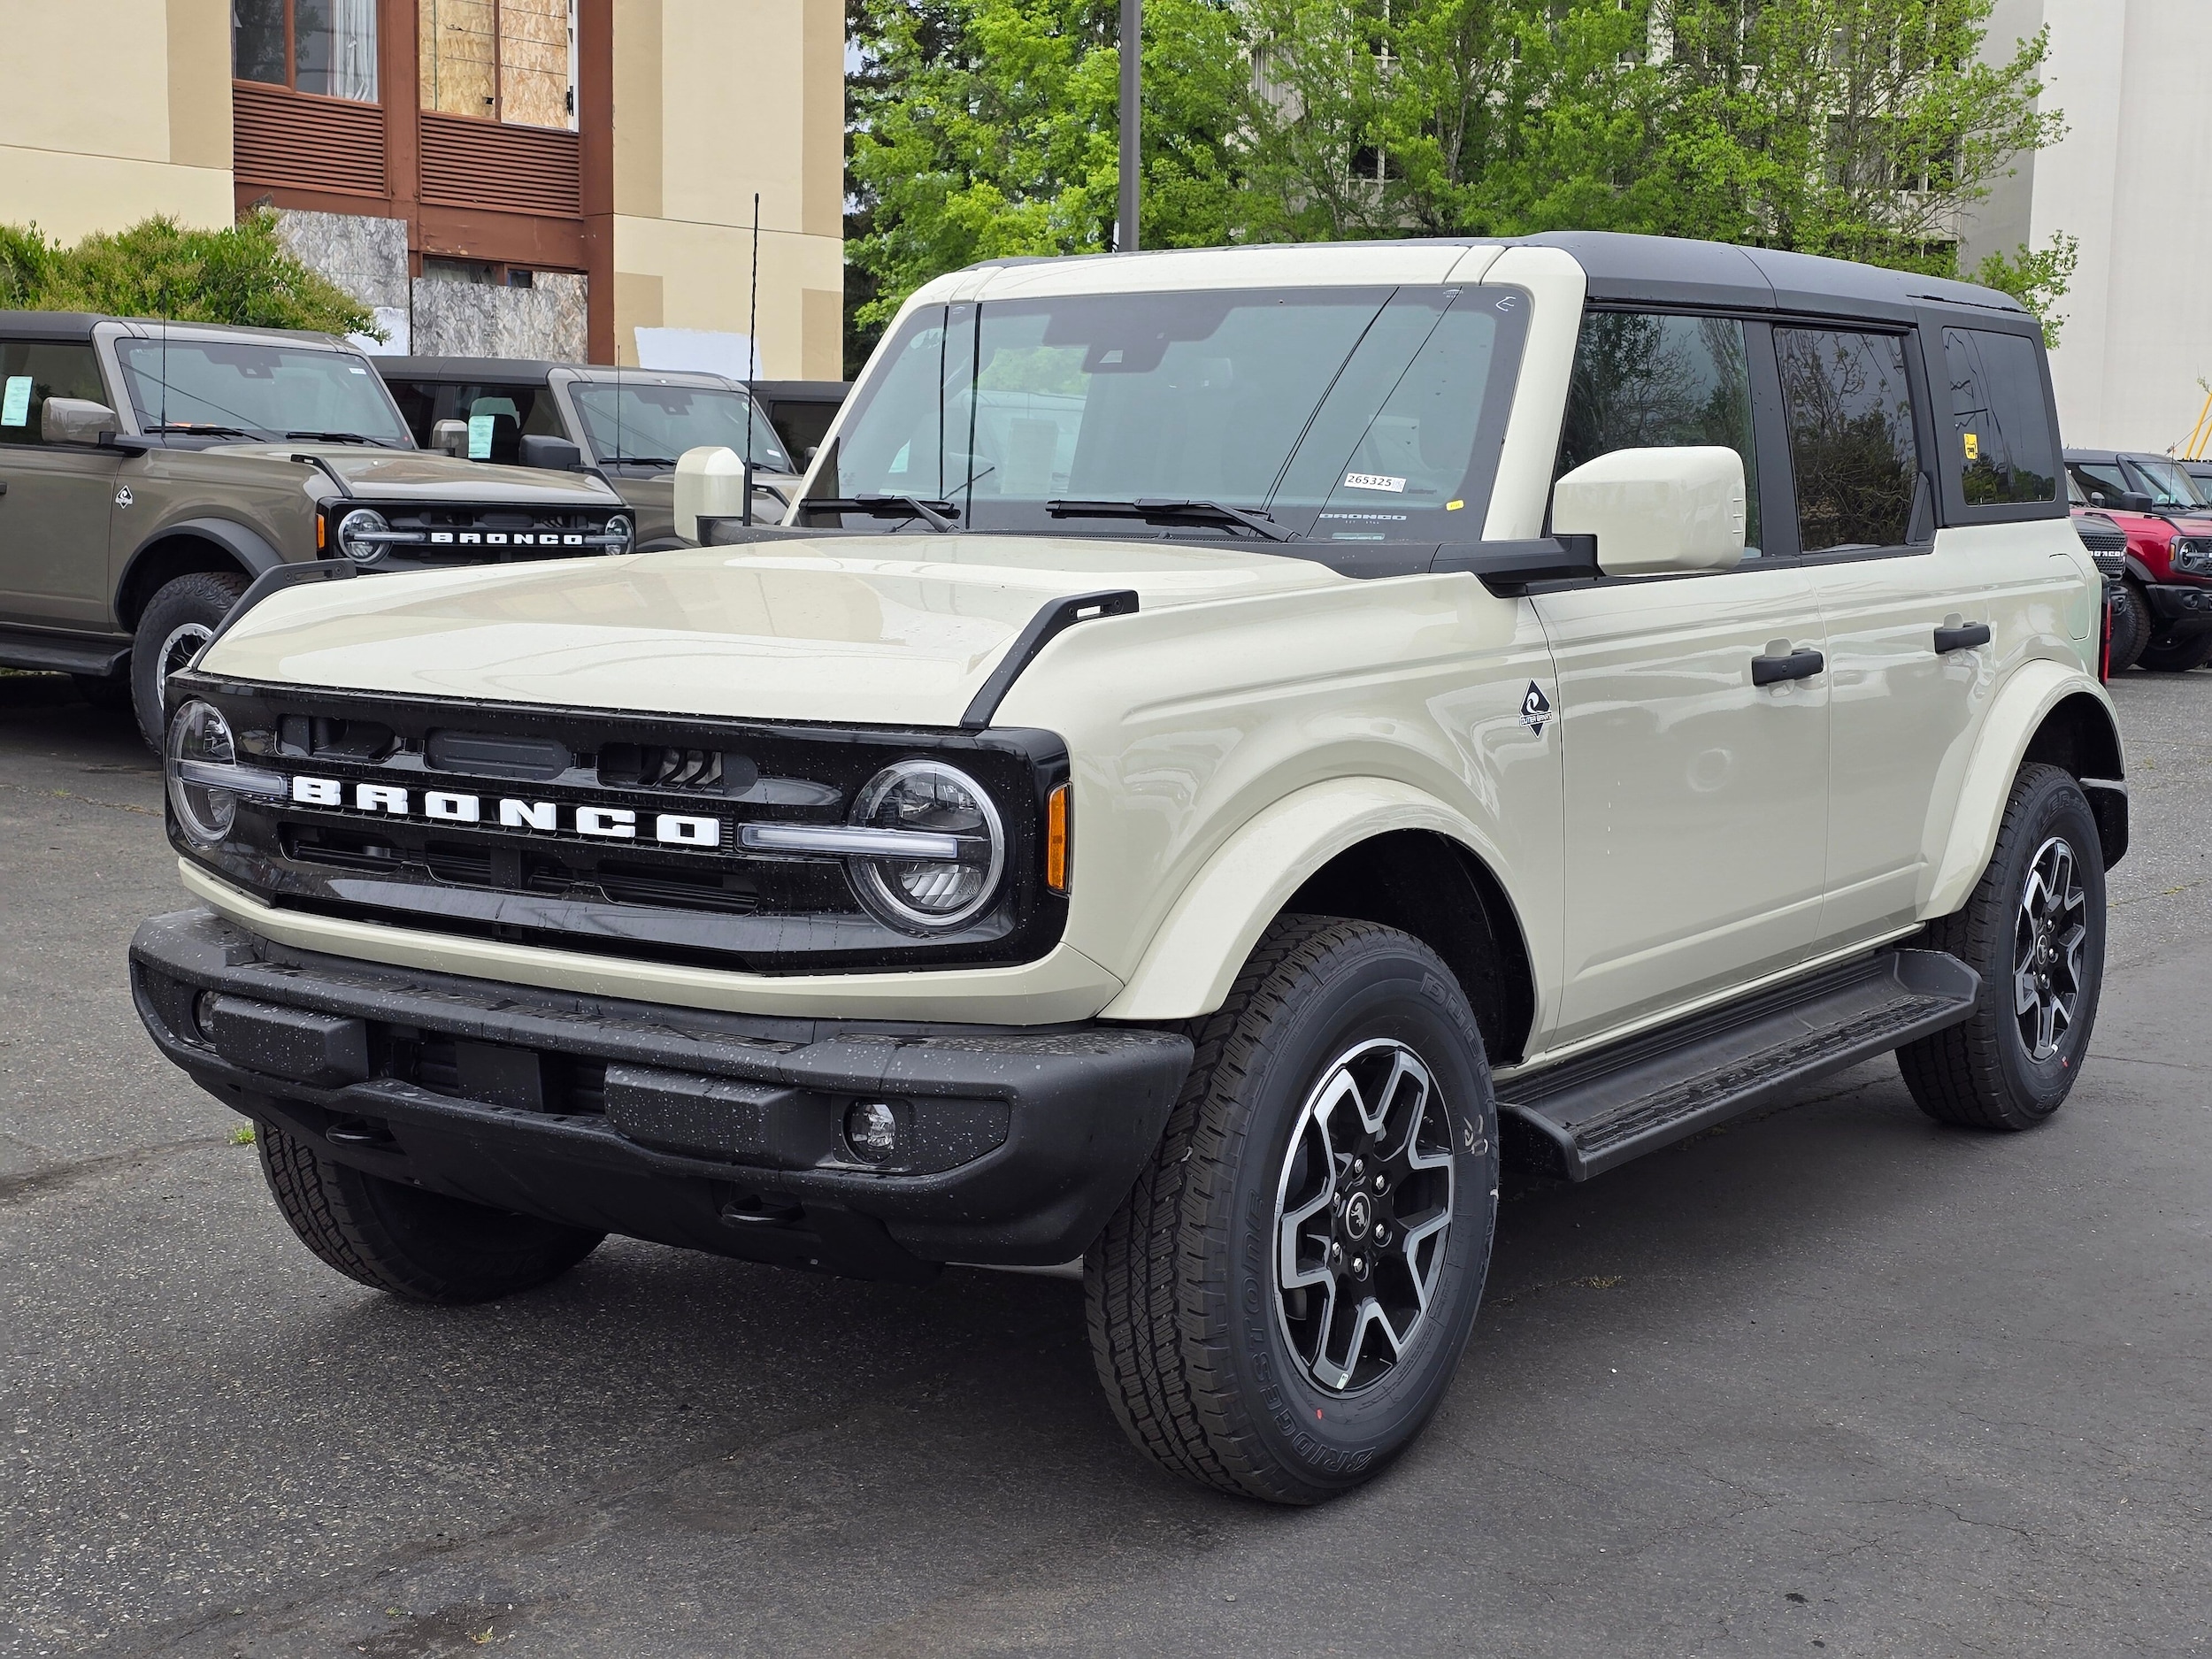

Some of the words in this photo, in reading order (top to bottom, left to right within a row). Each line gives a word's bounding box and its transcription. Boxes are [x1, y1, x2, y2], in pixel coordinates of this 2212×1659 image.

[1348, 474, 1392, 487] 265325
[431, 532, 582, 545] BRONCO
[292, 775, 720, 847] BRONCO
[1240, 1188, 1377, 1473] BRIDGESTONE
